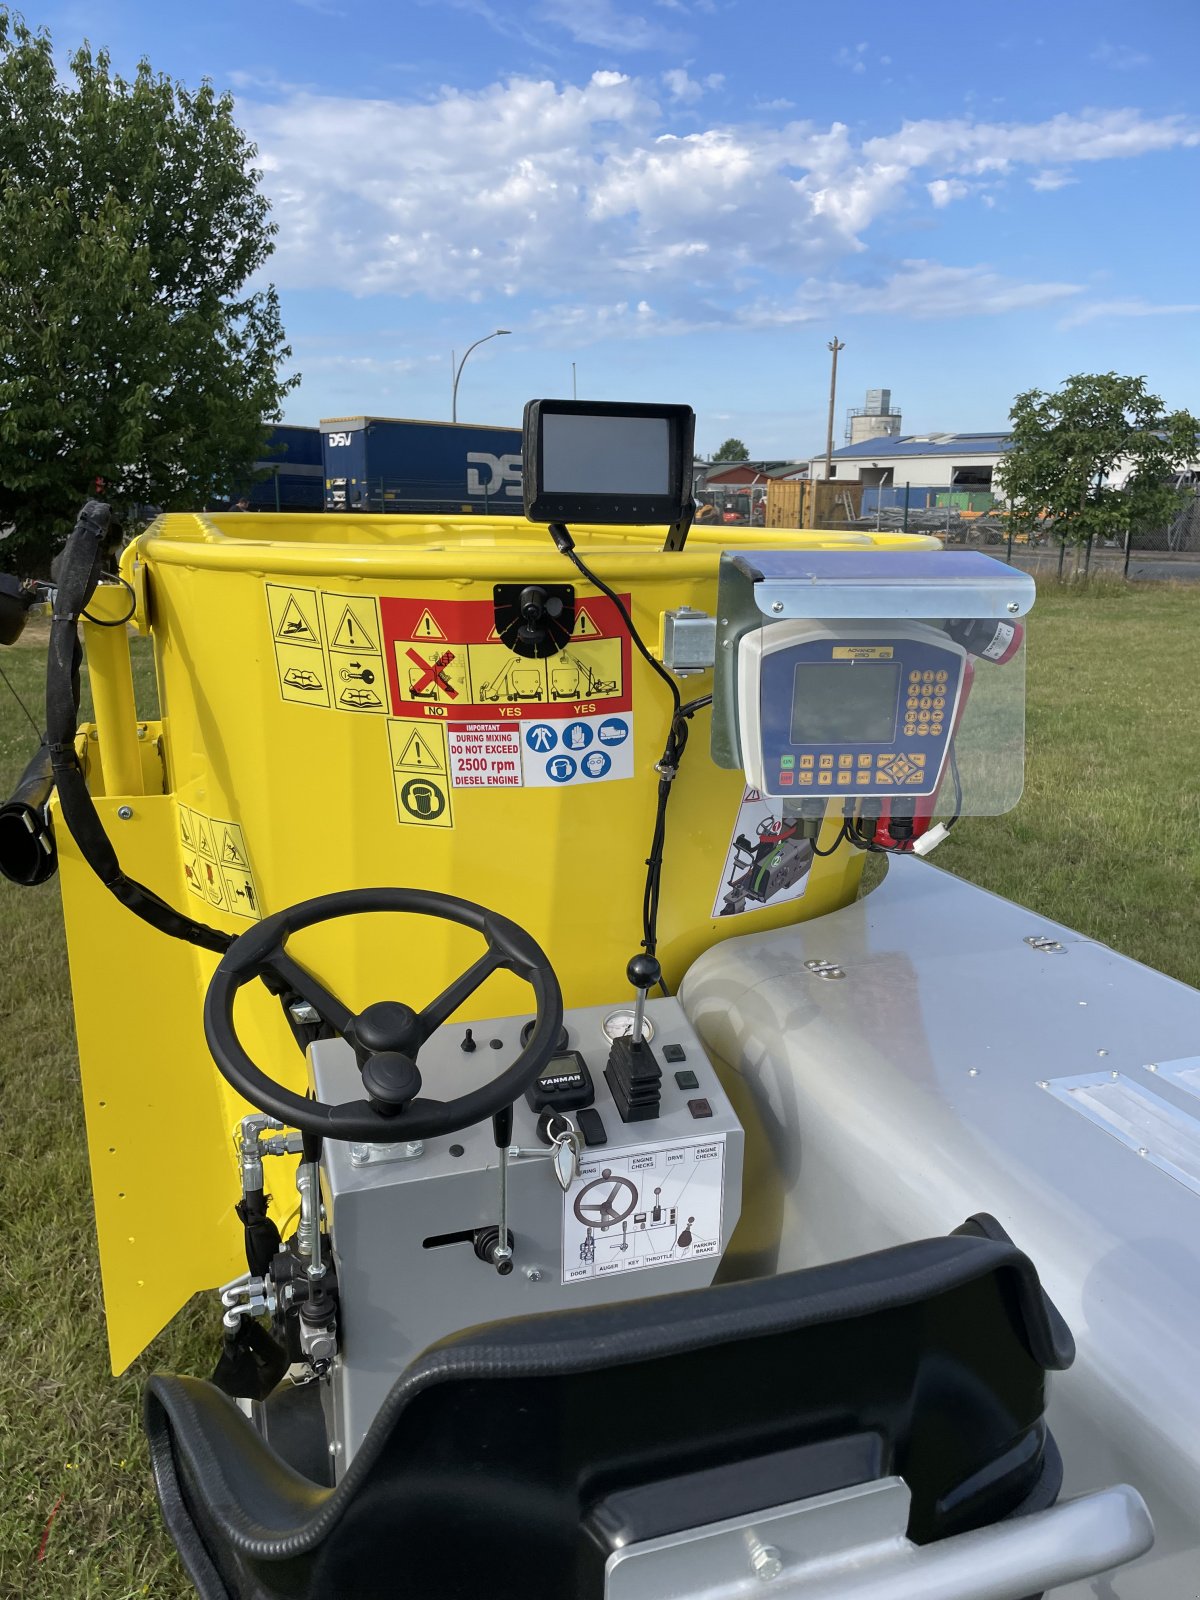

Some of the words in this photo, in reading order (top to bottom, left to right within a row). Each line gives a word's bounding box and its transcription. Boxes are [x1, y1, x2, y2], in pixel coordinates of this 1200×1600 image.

[329, 432, 352, 447] DSV
[467, 452, 523, 496] DS
[428, 706, 444, 716] NO
[499, 707, 522, 716] YES
[574, 703, 596, 714] YES
[456, 734, 484, 742] DURING
[486, 734, 512, 742] MIXING
[451, 745, 463, 754] DO
[465, 745, 482, 754] NOT
[485, 745, 519, 754] EXCEED
[457, 758, 487, 771] 2500
[491, 761, 515, 774] rpm
[455, 776, 485, 785] DIESEL
[487, 775, 519, 784] ENGINE
[541, 1075, 581, 1086] YANMAR
[696, 1146, 717, 1154] ENGINE
[632, 1156, 653, 1164] ENGINE
[696, 1152, 718, 1160] CHECKS
[631, 1162, 654, 1170] CHECKS
[693, 1240, 717, 1249] PARKING
[695, 1246, 714, 1254] BRAKE
[645, 1253, 673, 1263] THROTTLE
[599, 1263, 619, 1271] AUGER
[570, 1269, 587, 1277] DOOR
